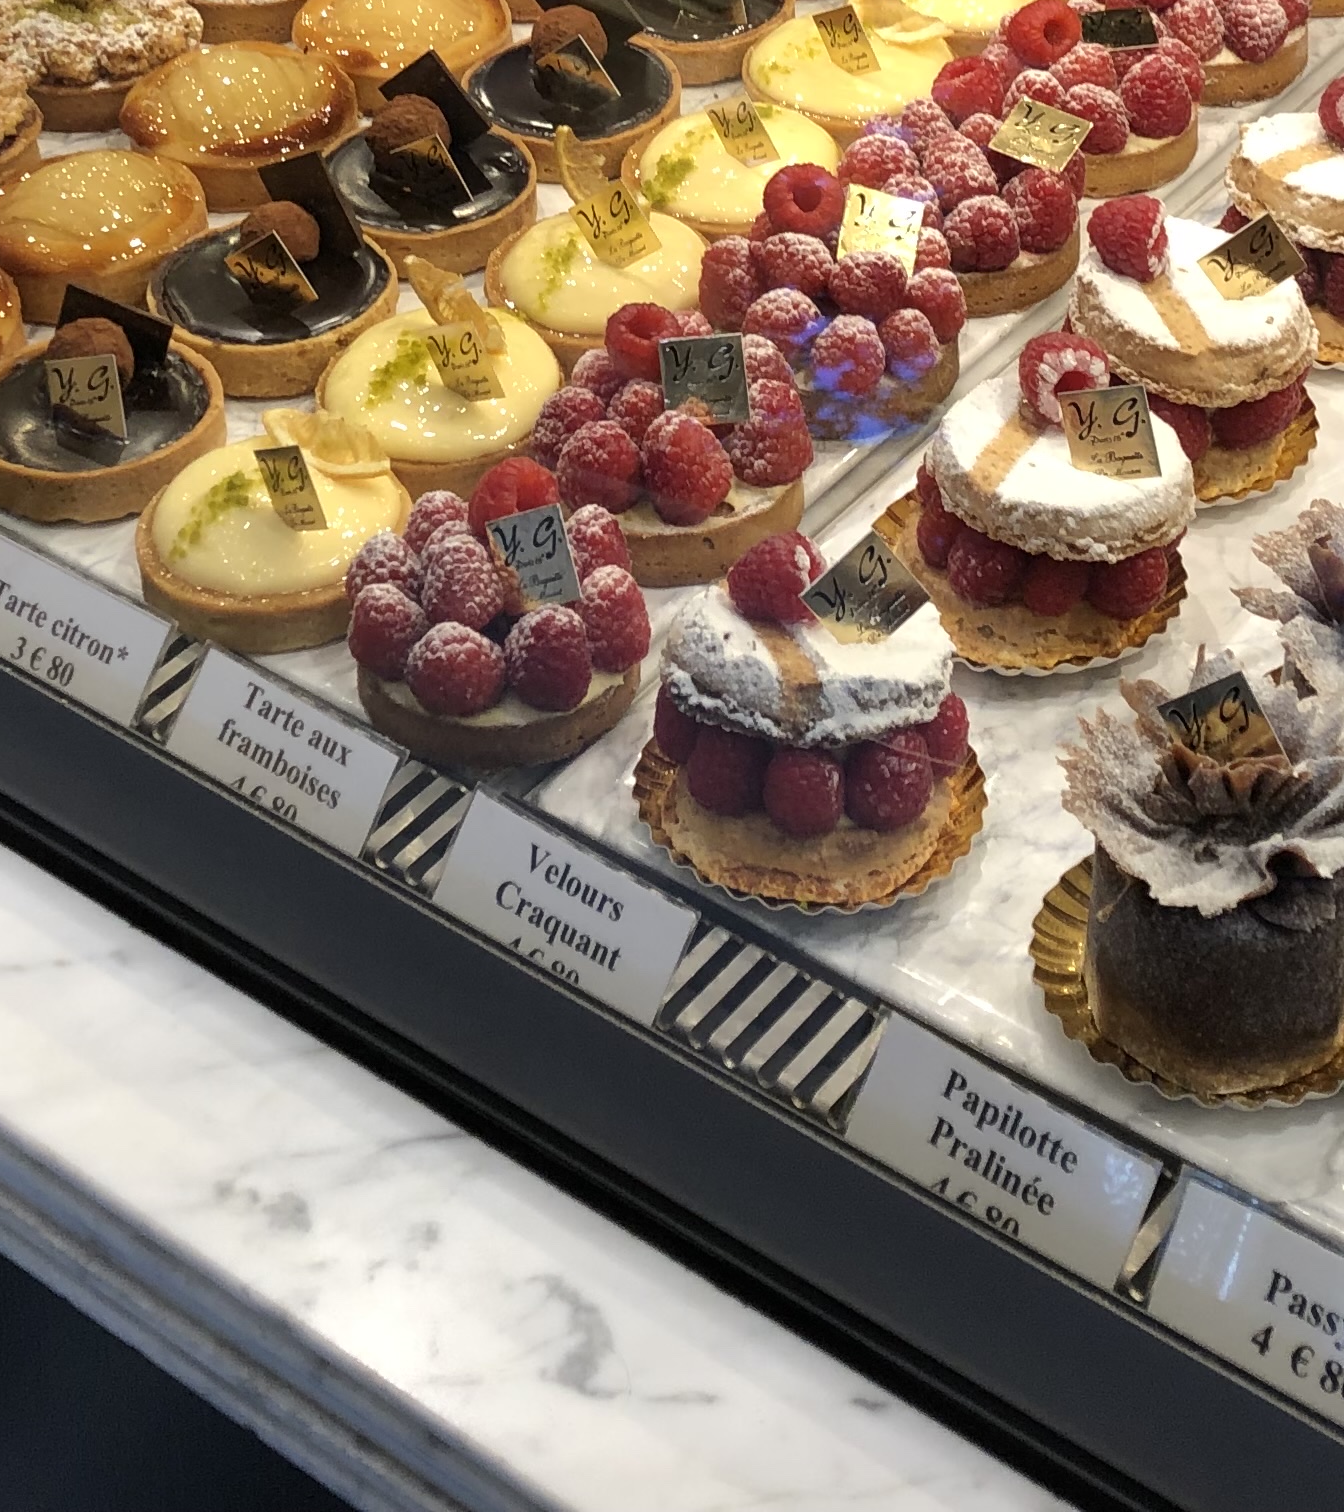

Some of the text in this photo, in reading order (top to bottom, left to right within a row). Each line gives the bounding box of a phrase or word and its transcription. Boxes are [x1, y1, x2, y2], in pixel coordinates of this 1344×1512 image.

[576, 203, 607, 240] Y.
[609, 190, 634, 226] G.
[427, 332, 483, 368] Y. G.
[669, 342, 739, 381] Y. G.
[51, 366, 114, 402] Y. G.
[1068, 397, 1147, 441] Y. G.
[492, 523, 525, 567] Y.
[533, 515, 563, 559] G.
[814, 544, 892, 623] Y. G.
[10, 637, 75, 688] 3 € 80
[243, 681, 353, 767] Tarte aux
[216, 719, 342, 810] framboises
[529, 842, 625, 922] Velours
[495, 881, 622, 973] Craquant
[943, 1068, 1079, 1174] Papilotte
[928, 1116, 1056, 1216] Pralinée
[1250, 1325, 1275, 1357] 4
[1289, 1345, 1316, 1379] €
